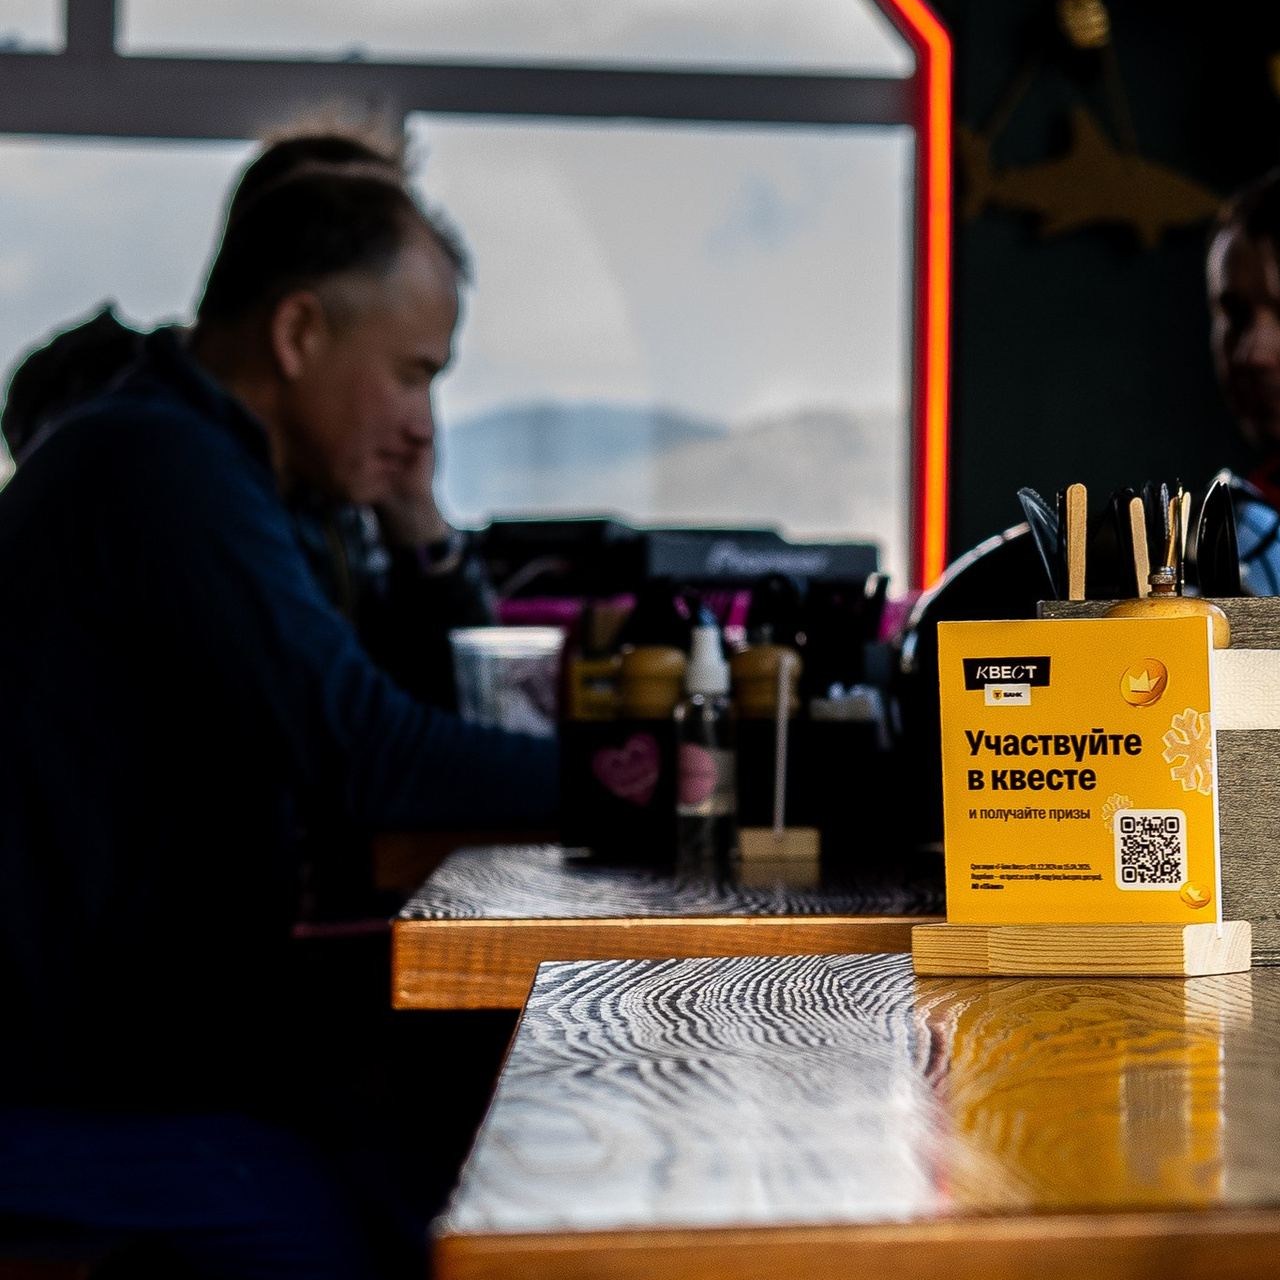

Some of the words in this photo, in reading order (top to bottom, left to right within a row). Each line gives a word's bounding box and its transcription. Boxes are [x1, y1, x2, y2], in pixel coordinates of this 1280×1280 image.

[976, 665, 1037, 679] КВЕСТ
[965, 728, 1142, 762] Участвуйте
[967, 769, 985, 790] в
[991, 768, 1097, 791] квесте
[968, 808, 977, 819] и
[980, 806, 1046, 822] получайте
[1049, 808, 1091, 822] призы
